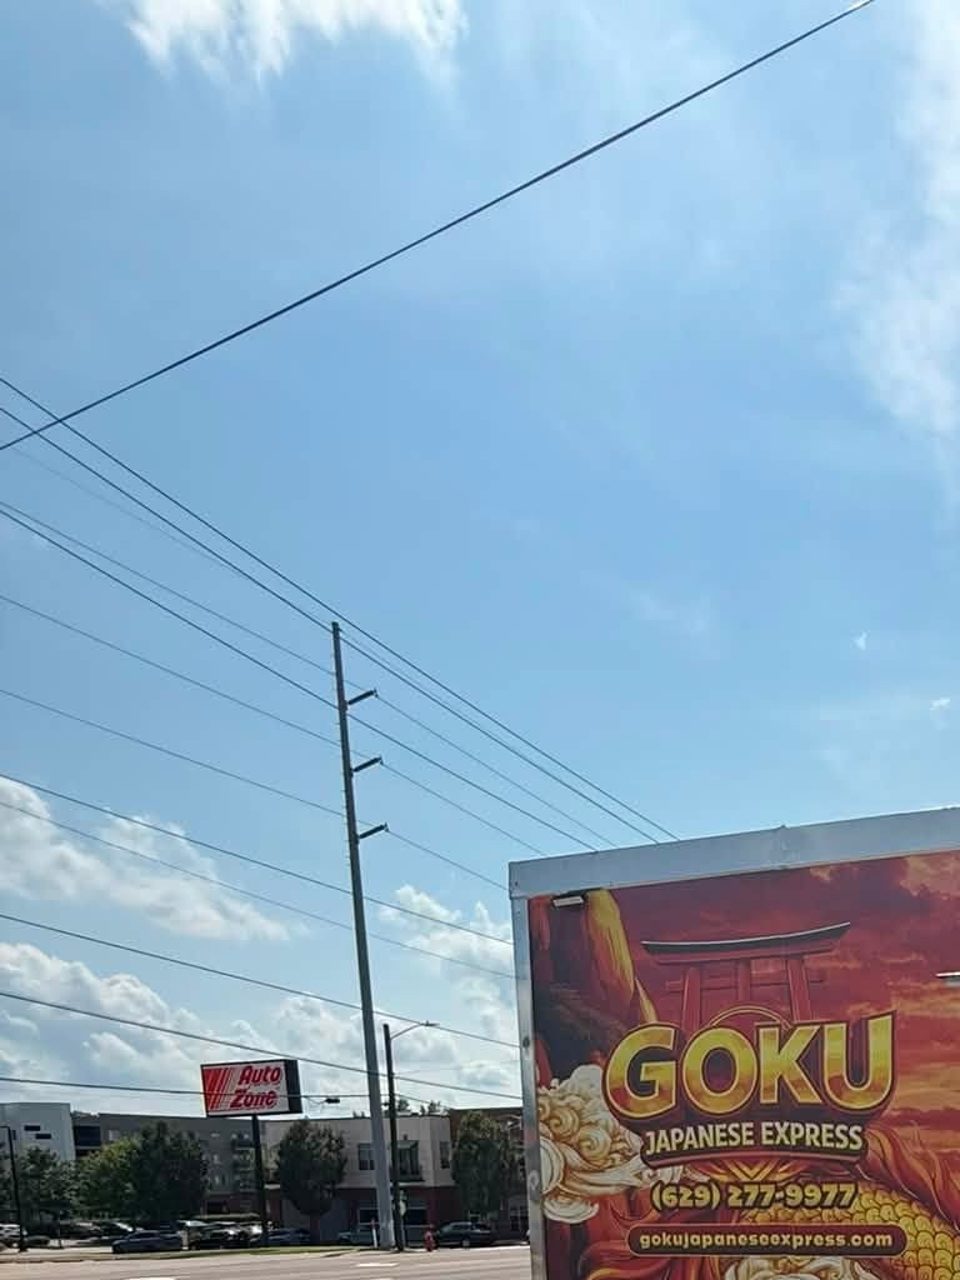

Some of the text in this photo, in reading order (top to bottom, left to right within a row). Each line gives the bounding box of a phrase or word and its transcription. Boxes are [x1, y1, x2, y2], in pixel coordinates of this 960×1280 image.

[237, 1065, 281, 1085] Auto
[605, 1012, 894, 1118] GOKU
[230, 1088, 278, 1108] Zone
[646, 1122, 863, 1155] JAPANESE EXPRESS
[652, 1183, 856, 1210] (629) 277-9977
[639, 1231, 893, 1250] gokujapaneseexpress.com
